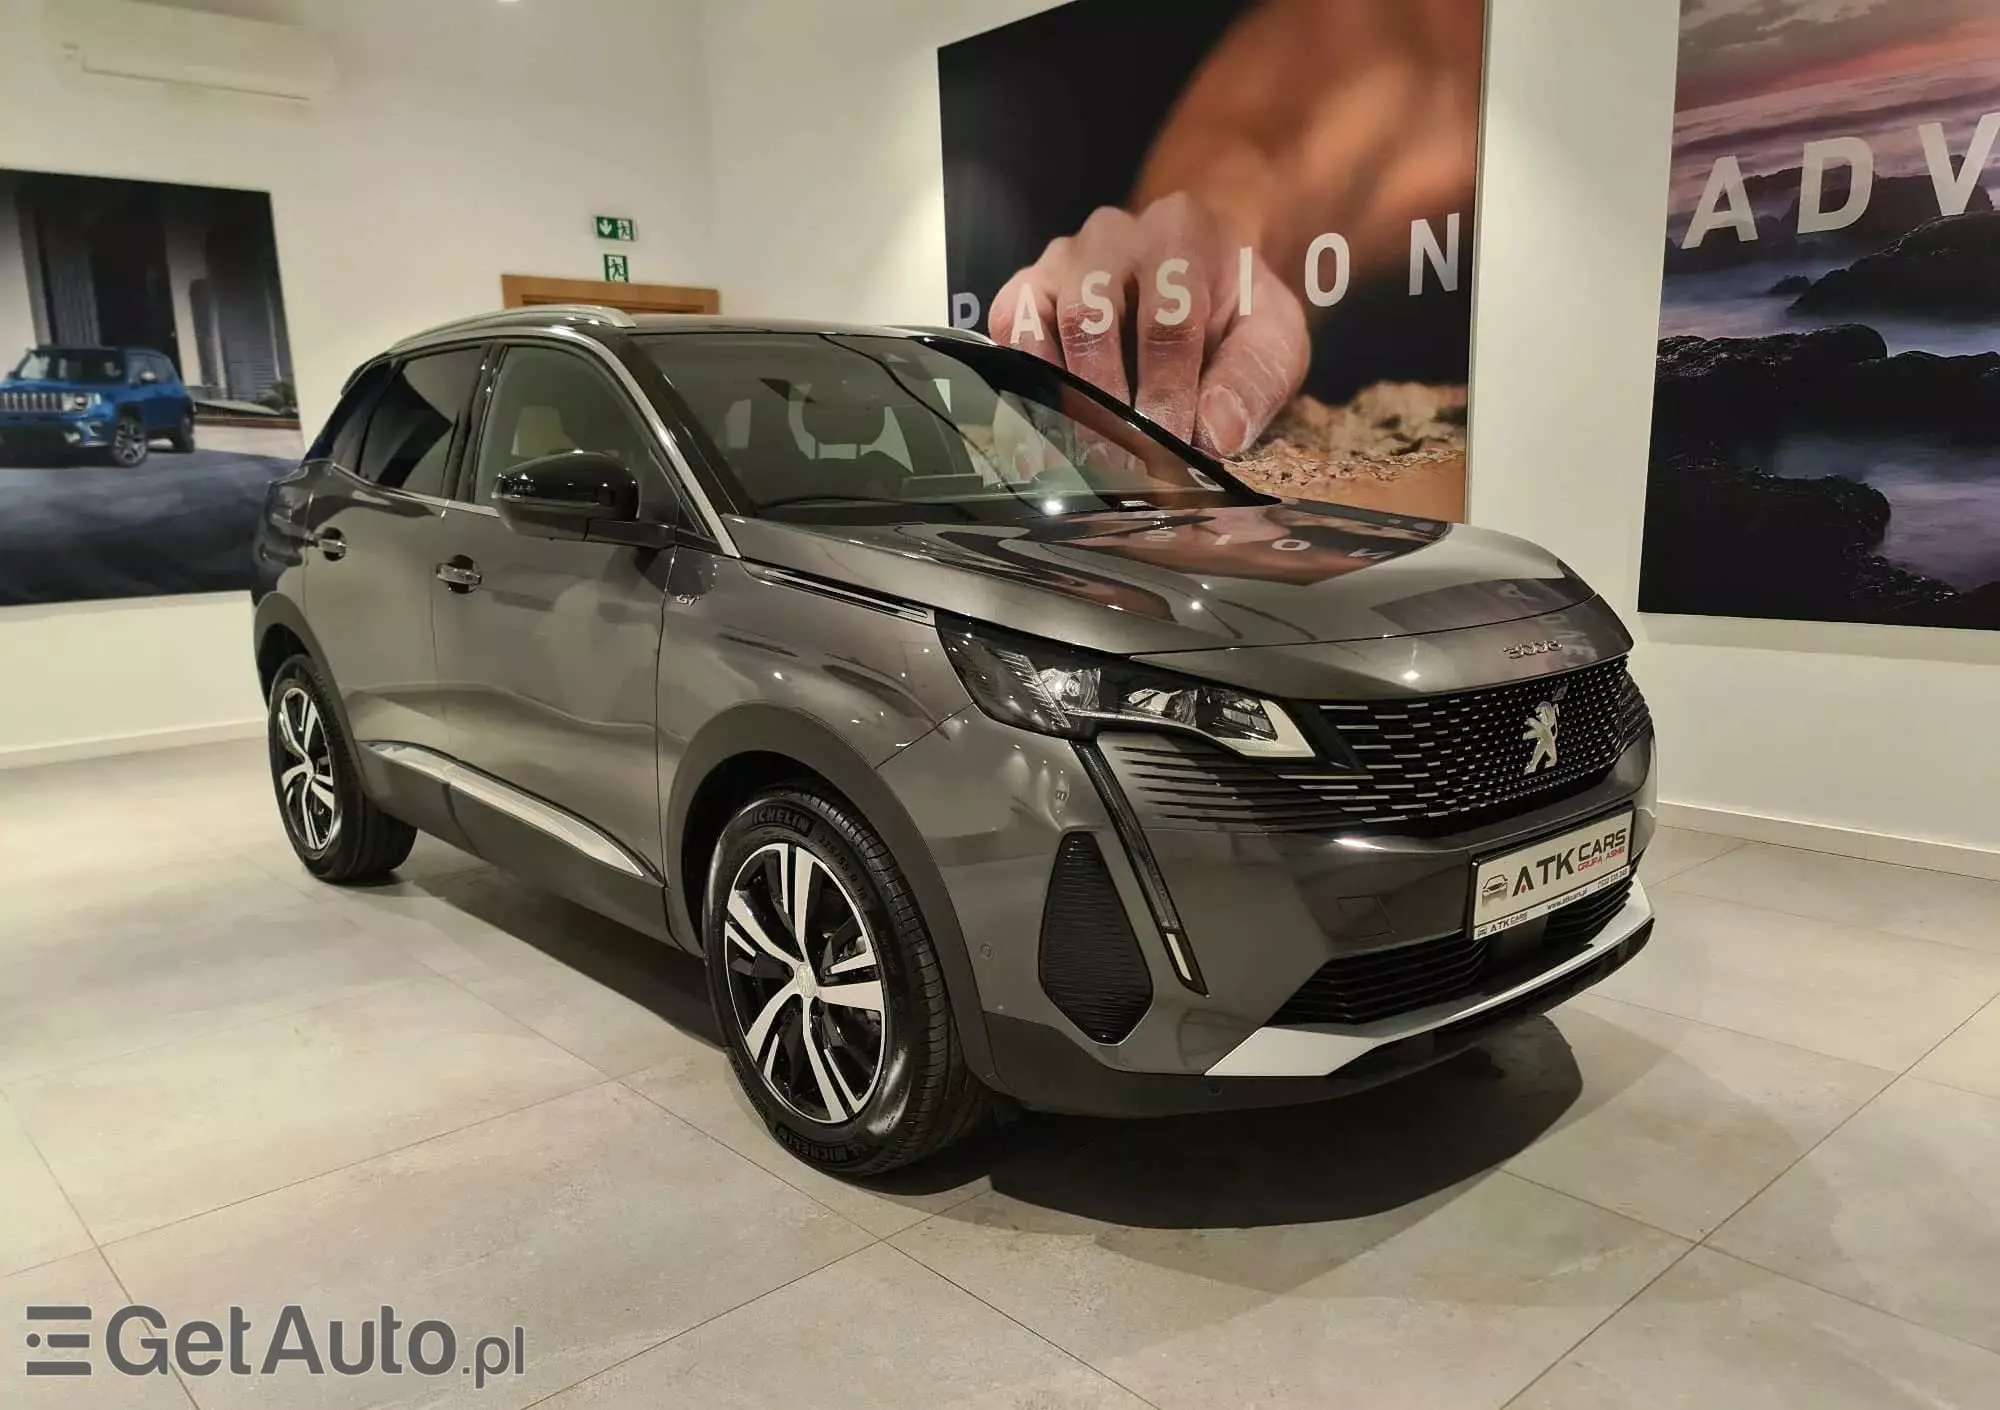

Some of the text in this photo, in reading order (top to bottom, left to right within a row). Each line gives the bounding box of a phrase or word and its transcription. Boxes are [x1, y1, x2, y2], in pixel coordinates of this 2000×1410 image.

[1681, 112, 2000, 249] ADV
[953, 212, 1460, 344] PASSION
[1512, 828, 1627, 897] ATK CARS
[1490, 918, 1510, 933] ATK
